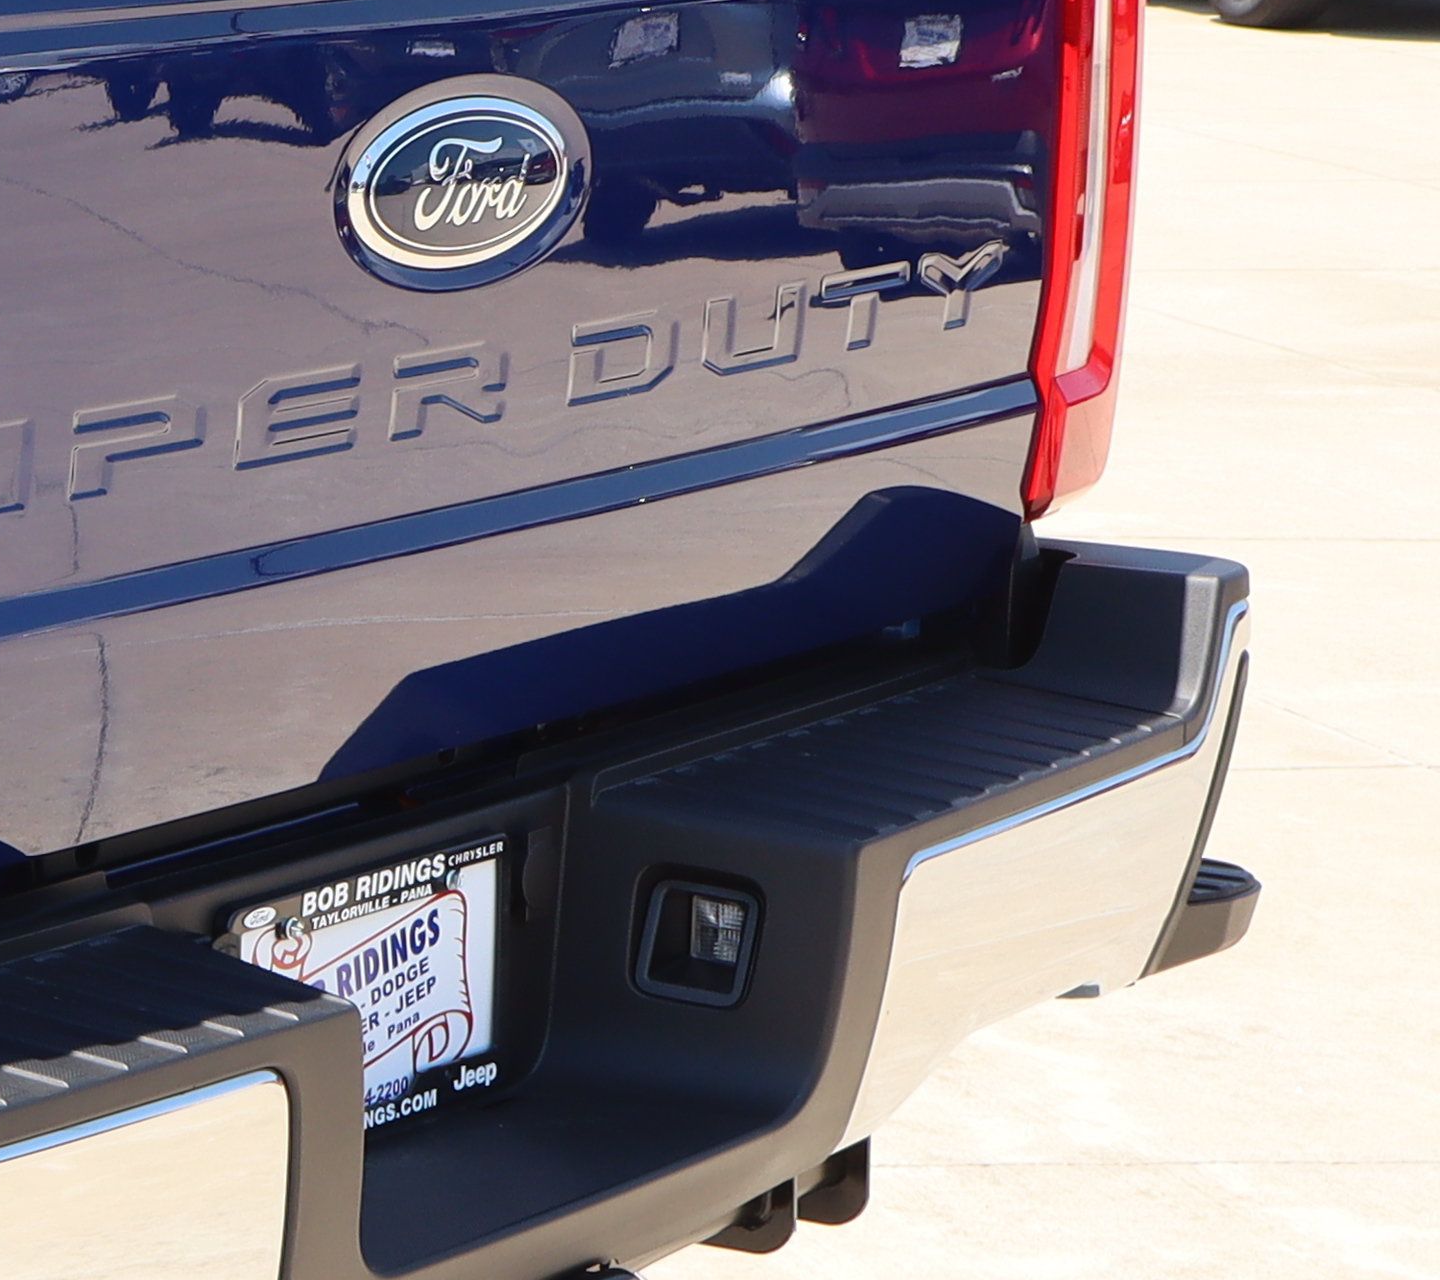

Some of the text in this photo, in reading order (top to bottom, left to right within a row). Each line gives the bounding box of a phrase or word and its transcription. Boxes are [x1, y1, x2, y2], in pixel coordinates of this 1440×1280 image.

[413, 135, 533, 232] Ford
[566, 238, 1006, 408] DUTY
[302, 841, 504, 918] BOB RIDINGS CHRYSLER
[311, 897, 390, 930] TAYLORVILLE
[399, 884, 433, 904] PANA
[336, 908, 441, 999] RIDINGS
[371, 956, 430, 1006] DODGE
[395, 976, 437, 1014] JEEP
[387, 1012, 421, 1040] Pana
[364, 1076, 409, 1107] 4-2200
[453, 1061, 498, 1091] Jeep
[364, 1089, 438, 1130] NGS.COM
